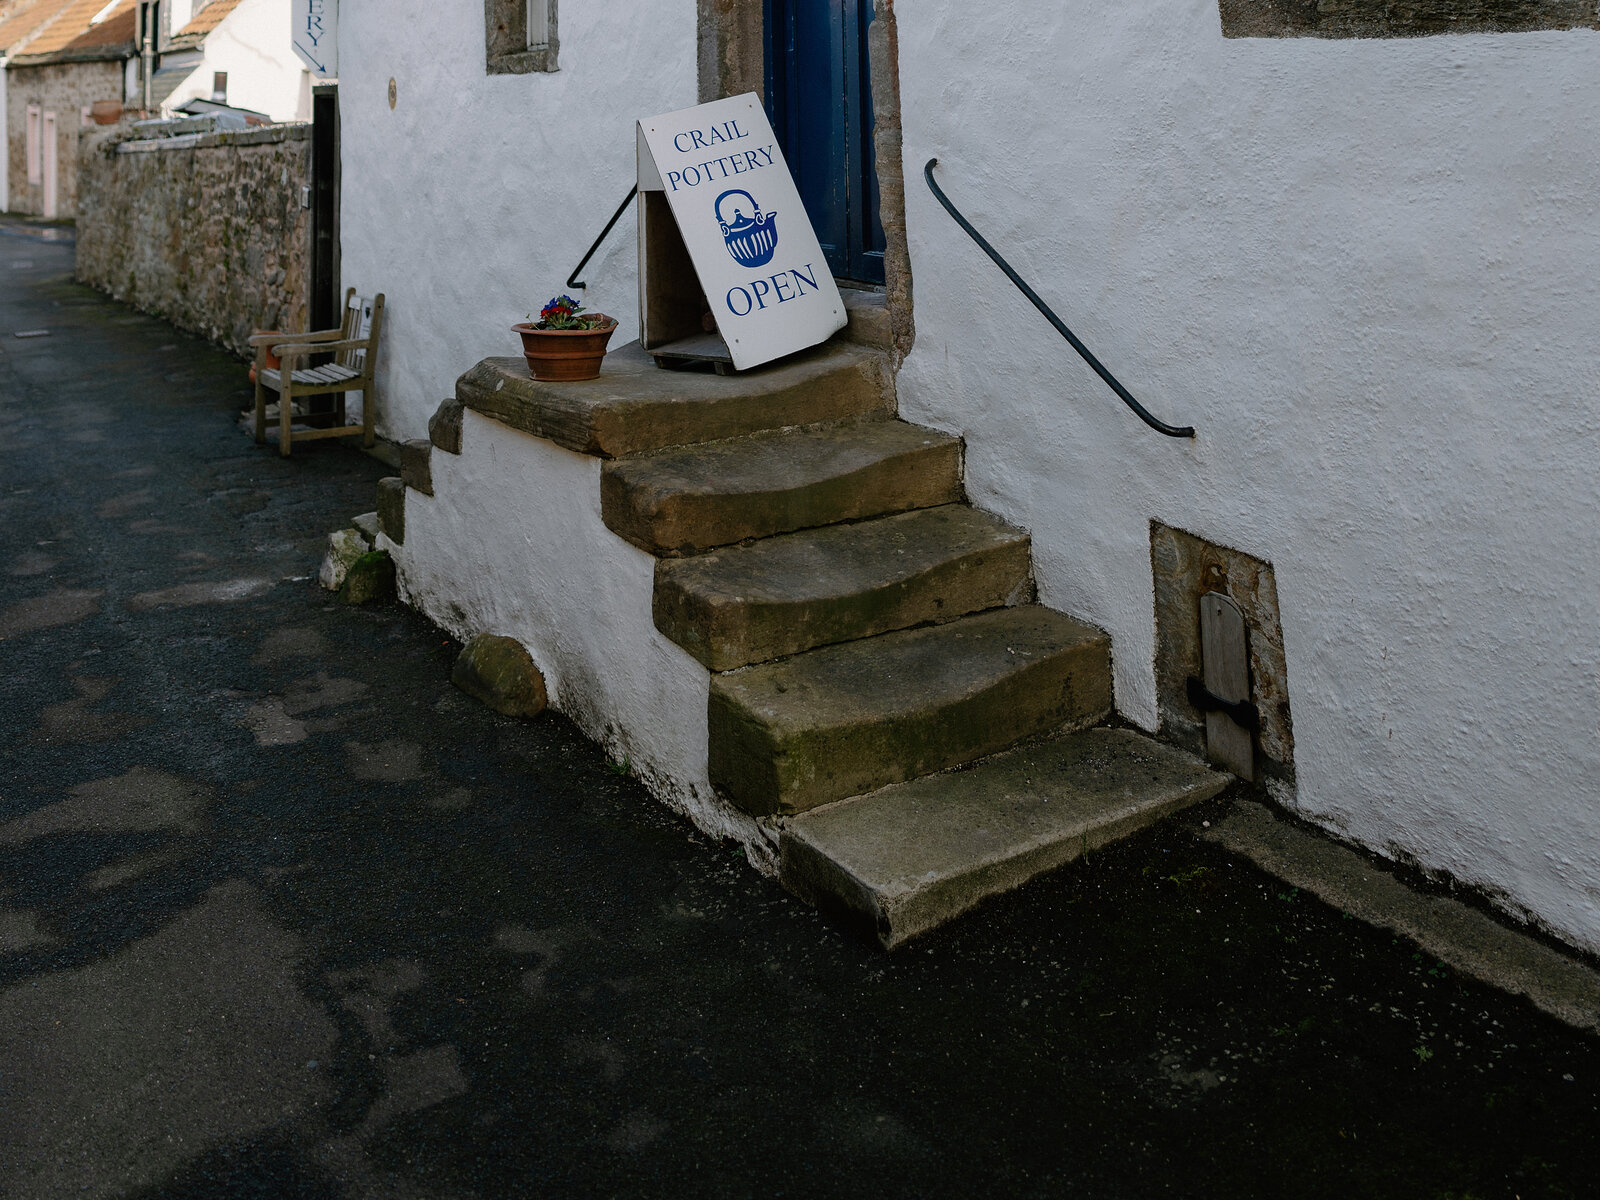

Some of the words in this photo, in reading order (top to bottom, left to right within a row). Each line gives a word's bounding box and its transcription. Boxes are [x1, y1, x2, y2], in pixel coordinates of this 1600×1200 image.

[673, 120, 749, 153] CRAIL
[666, 145, 775, 192] POTTERY
[726, 263, 820, 317] OPEN
